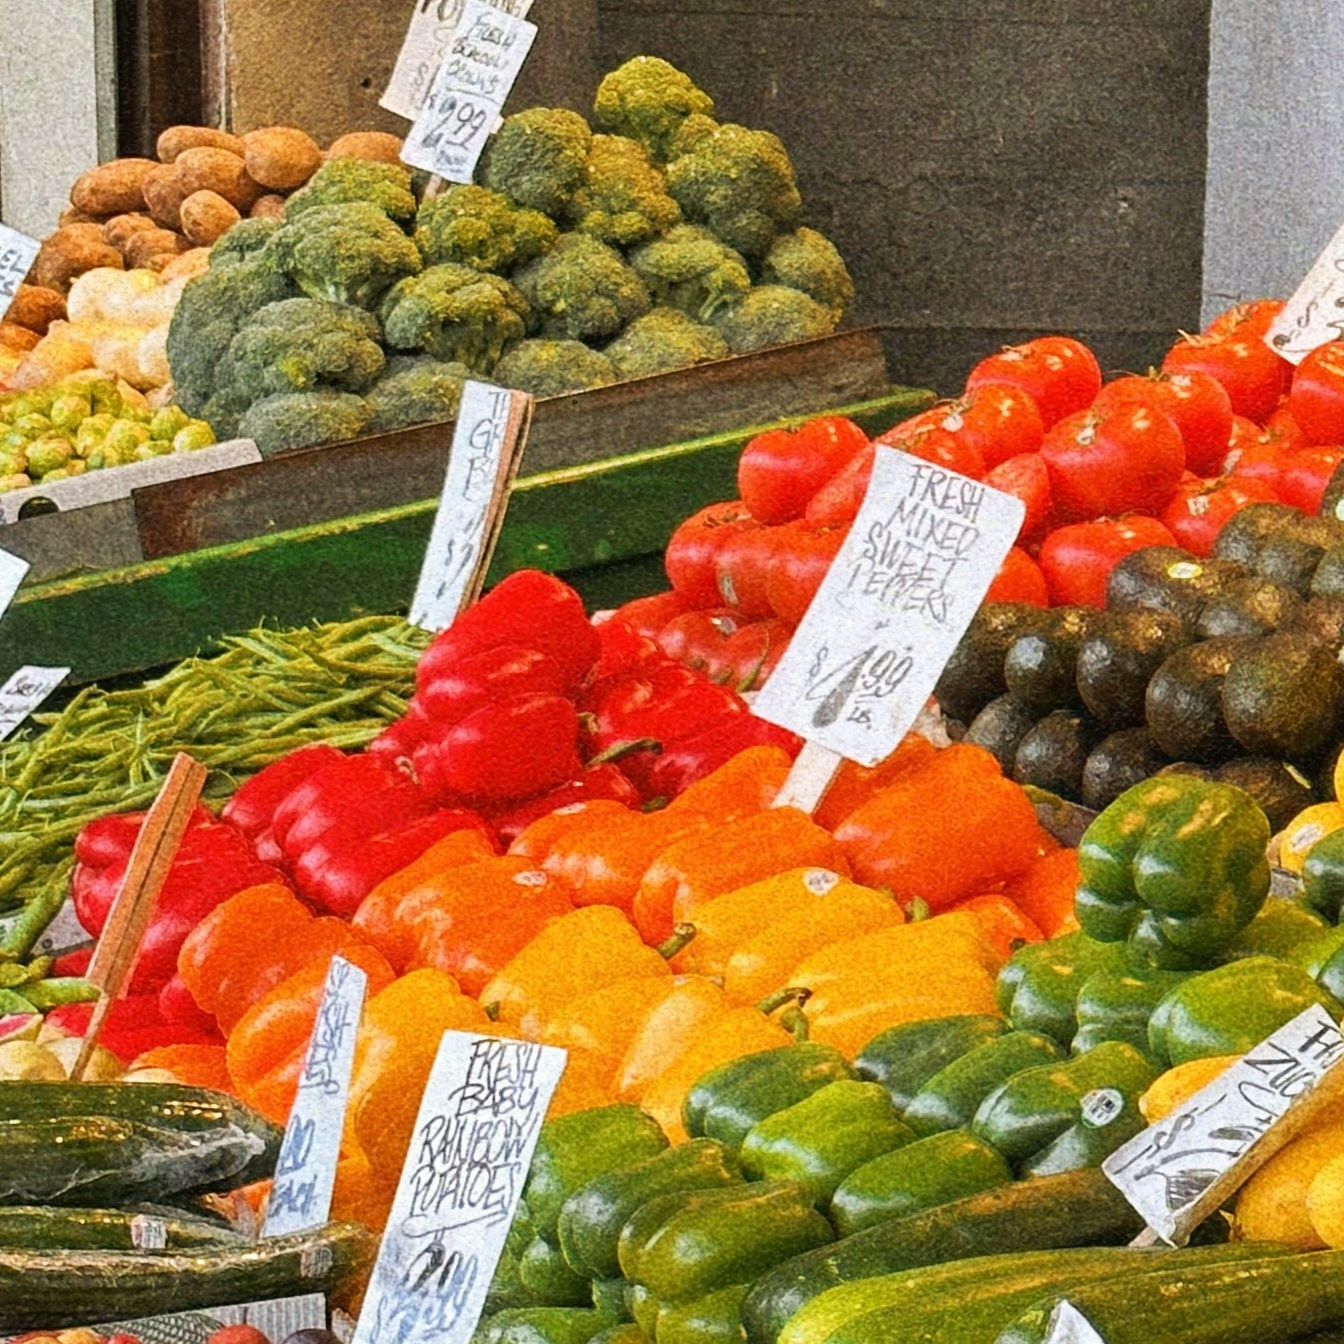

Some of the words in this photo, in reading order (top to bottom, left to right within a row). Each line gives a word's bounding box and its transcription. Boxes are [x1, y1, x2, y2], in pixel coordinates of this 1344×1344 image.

[467, 12, 517, 50] FRESH
[909, 464, 986, 523] FRESH
[884, 496, 980, 555] MIXED
[863, 521, 968, 590] SWEET
[848, 558, 955, 624] PEPPERS
[465, 1039, 543, 1092] FRESH
[448, 1083, 539, 1135] BABY
[419, 1113, 540, 1171] RAINBOW
[410, 1161, 522, 1219] POTATOES
